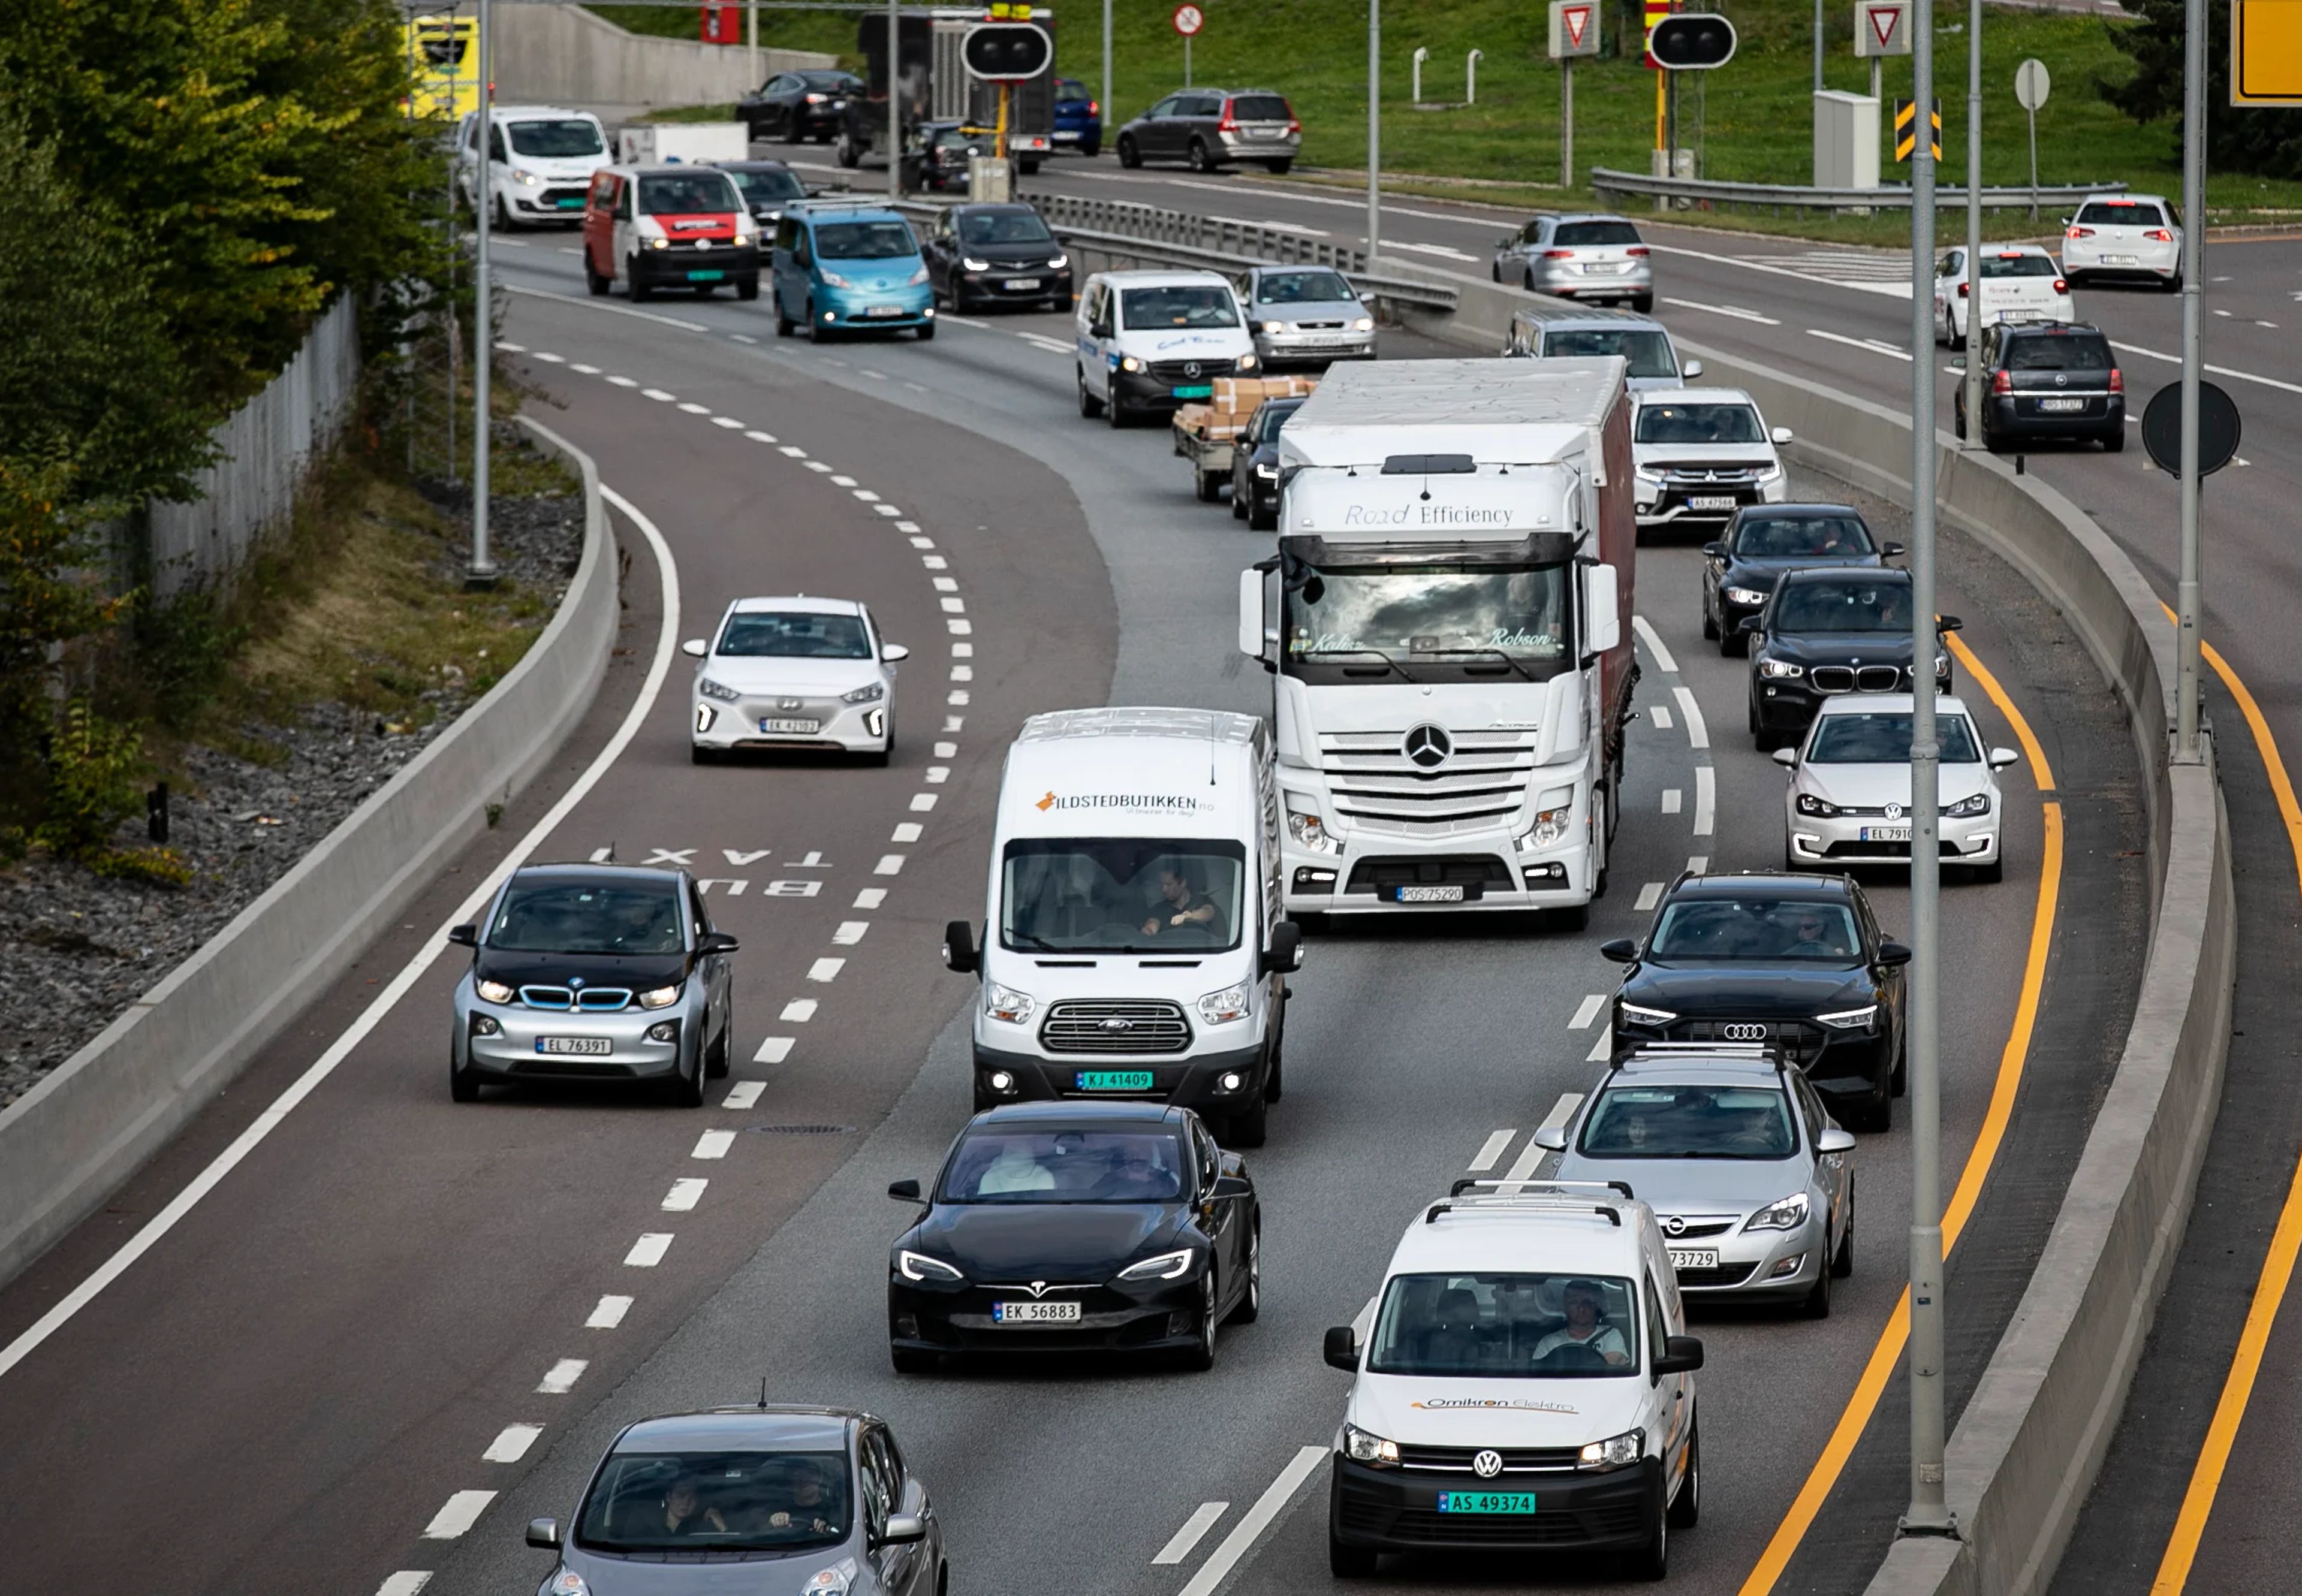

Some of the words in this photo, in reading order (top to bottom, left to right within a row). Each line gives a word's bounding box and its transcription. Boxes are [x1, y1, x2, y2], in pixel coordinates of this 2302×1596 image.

[1345, 504, 1410, 525] Road
[1421, 506, 1513, 527] Efficiency
[1487, 627, 1551, 647] Robson
[1872, 829, 1884, 839] EL
[1890, 829, 1912, 839] 7910
[697, 879, 823, 897] BU
[1404, 889, 1424, 900] POS
[1427, 889, 1461, 900] 75290
[549, 1039, 561, 1052] EL
[568, 1040, 605, 1052] 76391
[1089, 1074, 1104, 1086] KJ
[1110, 1074, 1148, 1086] 41409
[1006, 1305, 1023, 1319] EK
[1031, 1305, 1076, 1319] 56883
[1427, 1398, 1509, 1407] Omikron
[1512, 1398, 1574, 1411] Elektro
[1453, 1495, 1472, 1511] AS
[1480, 1496, 1530, 1511] 49374
